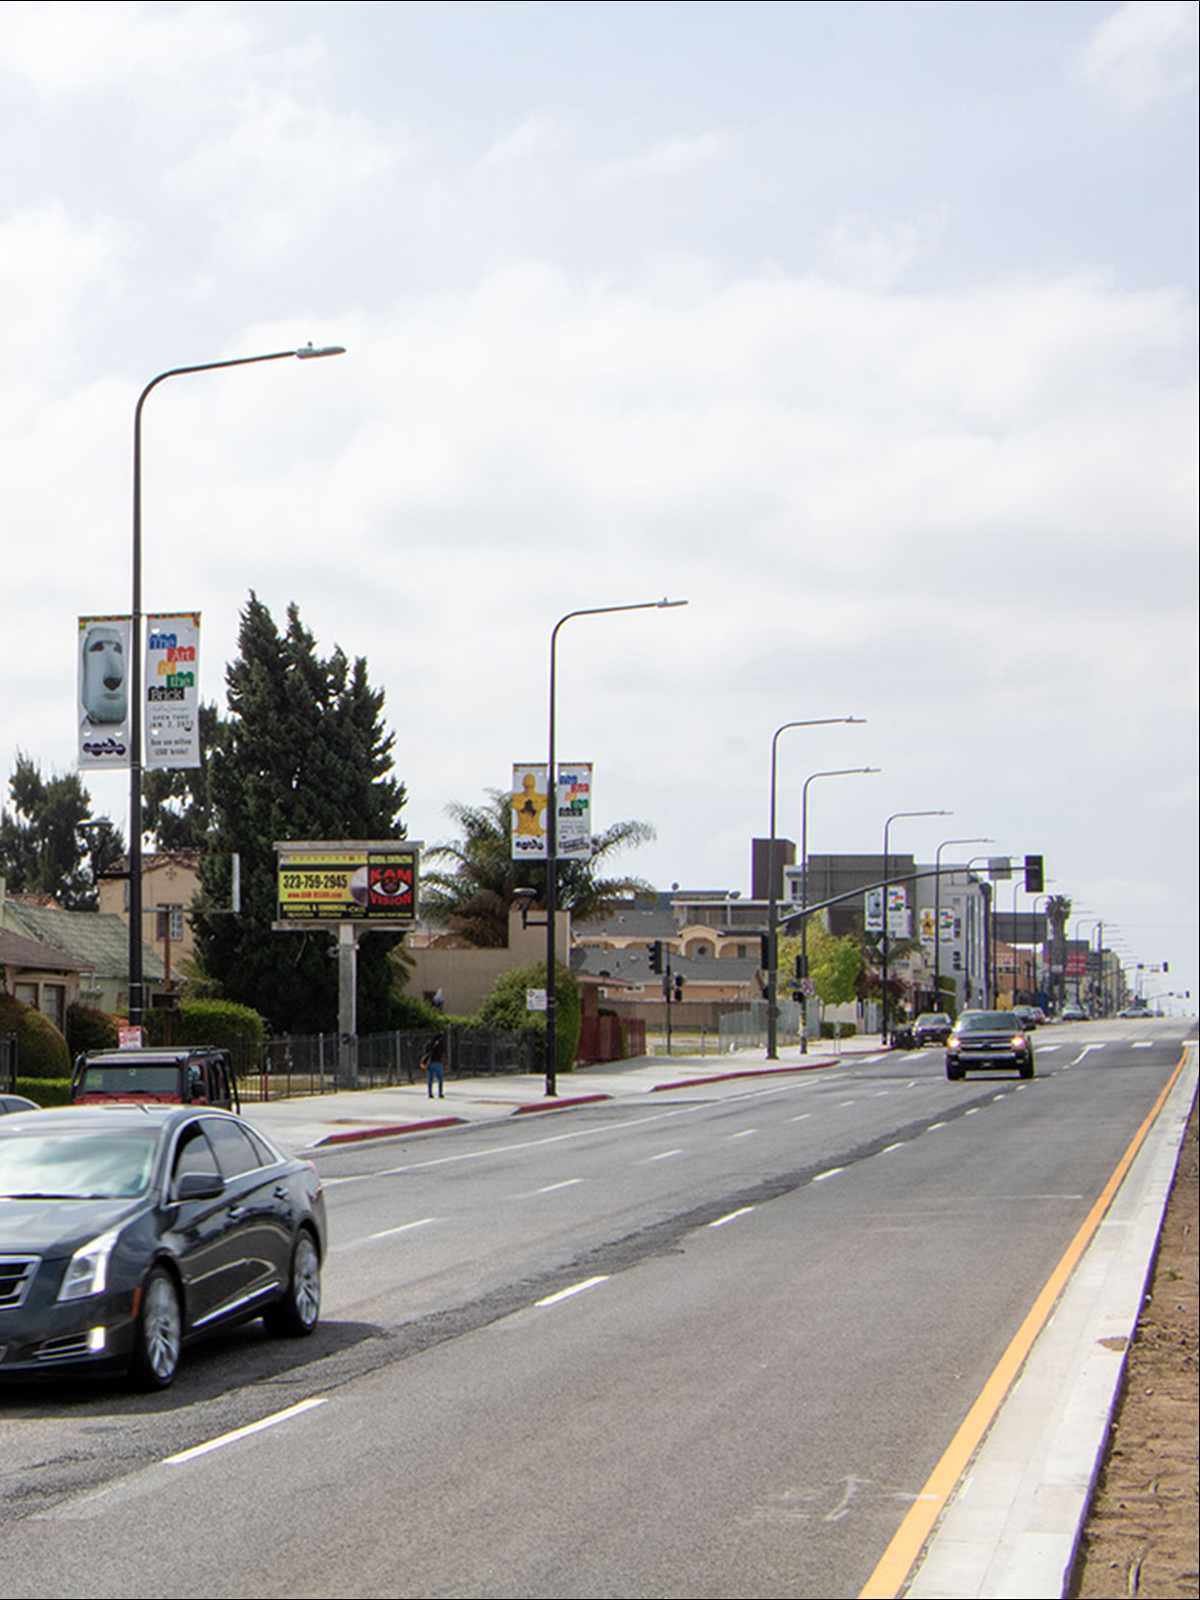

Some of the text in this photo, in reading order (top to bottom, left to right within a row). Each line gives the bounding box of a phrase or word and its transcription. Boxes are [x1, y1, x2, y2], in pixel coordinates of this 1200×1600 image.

[171, 649, 191, 662] Art
[170, 675, 191, 688] the
[150, 688, 182, 701] Brick
[370, 869, 412, 885] KAM
[369, 890, 412, 905] VISION
